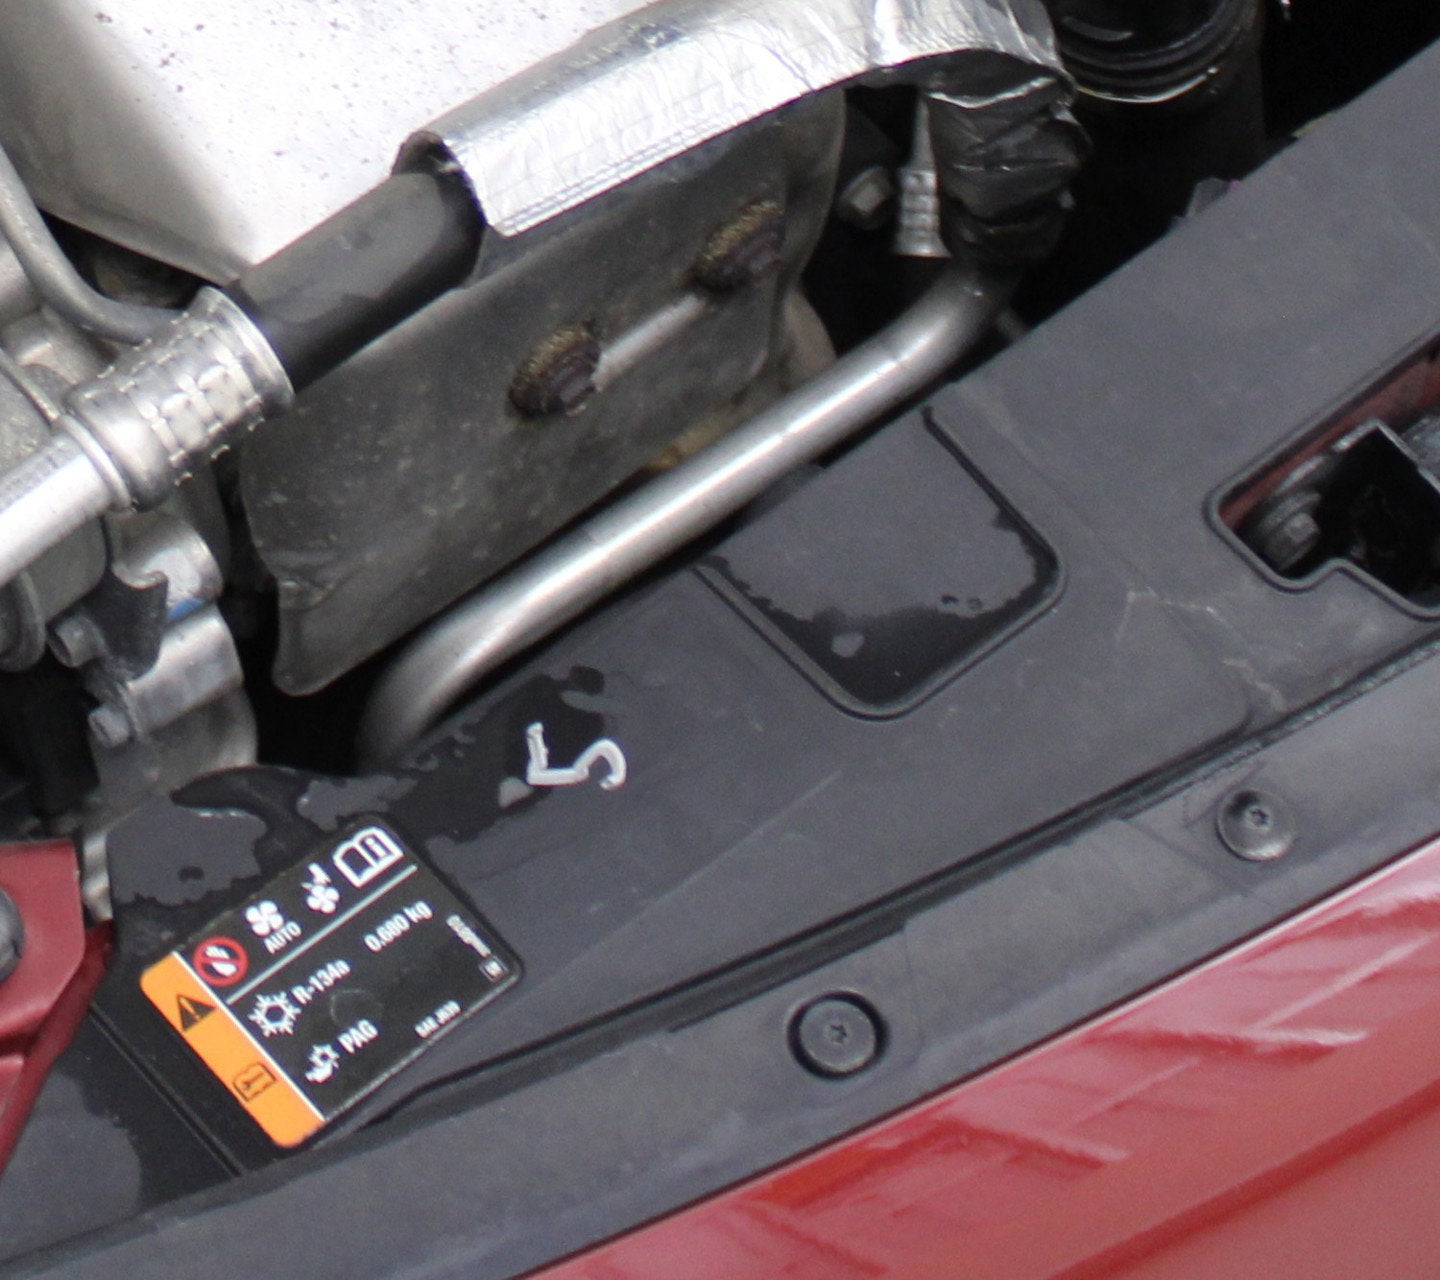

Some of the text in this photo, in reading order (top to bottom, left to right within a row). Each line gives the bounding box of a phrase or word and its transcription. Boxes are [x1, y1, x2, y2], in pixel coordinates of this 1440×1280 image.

[264, 921, 302, 954] AUTO
[291, 959, 351, 1005] R-134a
[404, 901, 434, 924] kg
[338, 1019, 379, 1054] PAG
